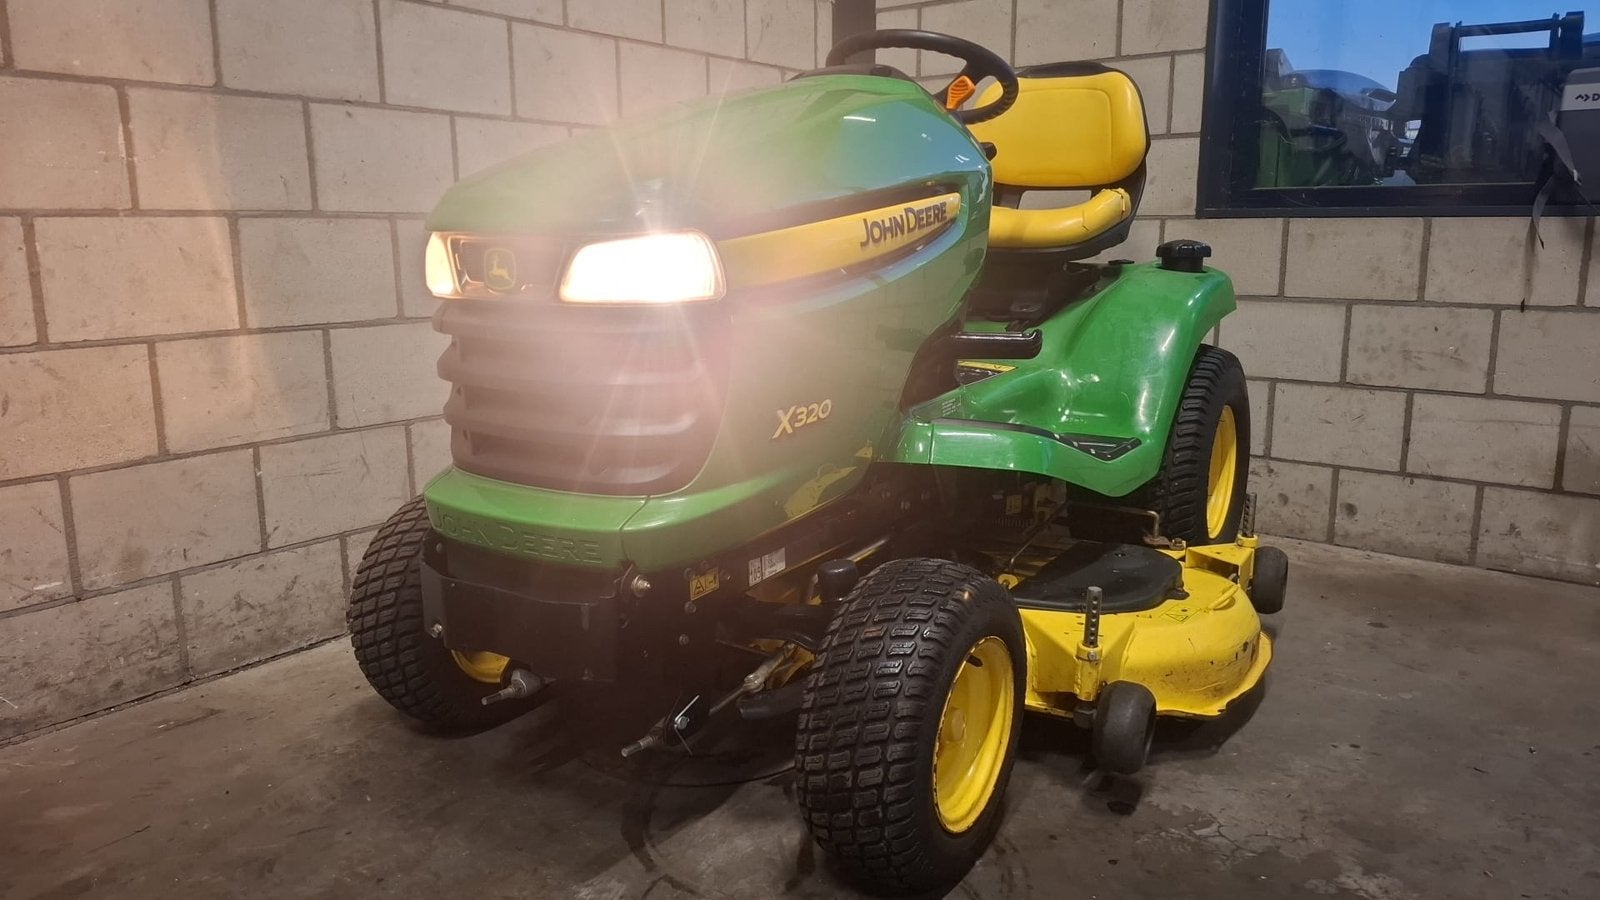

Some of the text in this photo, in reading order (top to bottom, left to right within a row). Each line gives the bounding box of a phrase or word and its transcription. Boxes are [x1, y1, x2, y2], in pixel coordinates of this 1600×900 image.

[860, 201, 948, 247] JOHN DEERE
[771, 398, 832, 439] X320
[497, 521, 602, 564] DEERE
